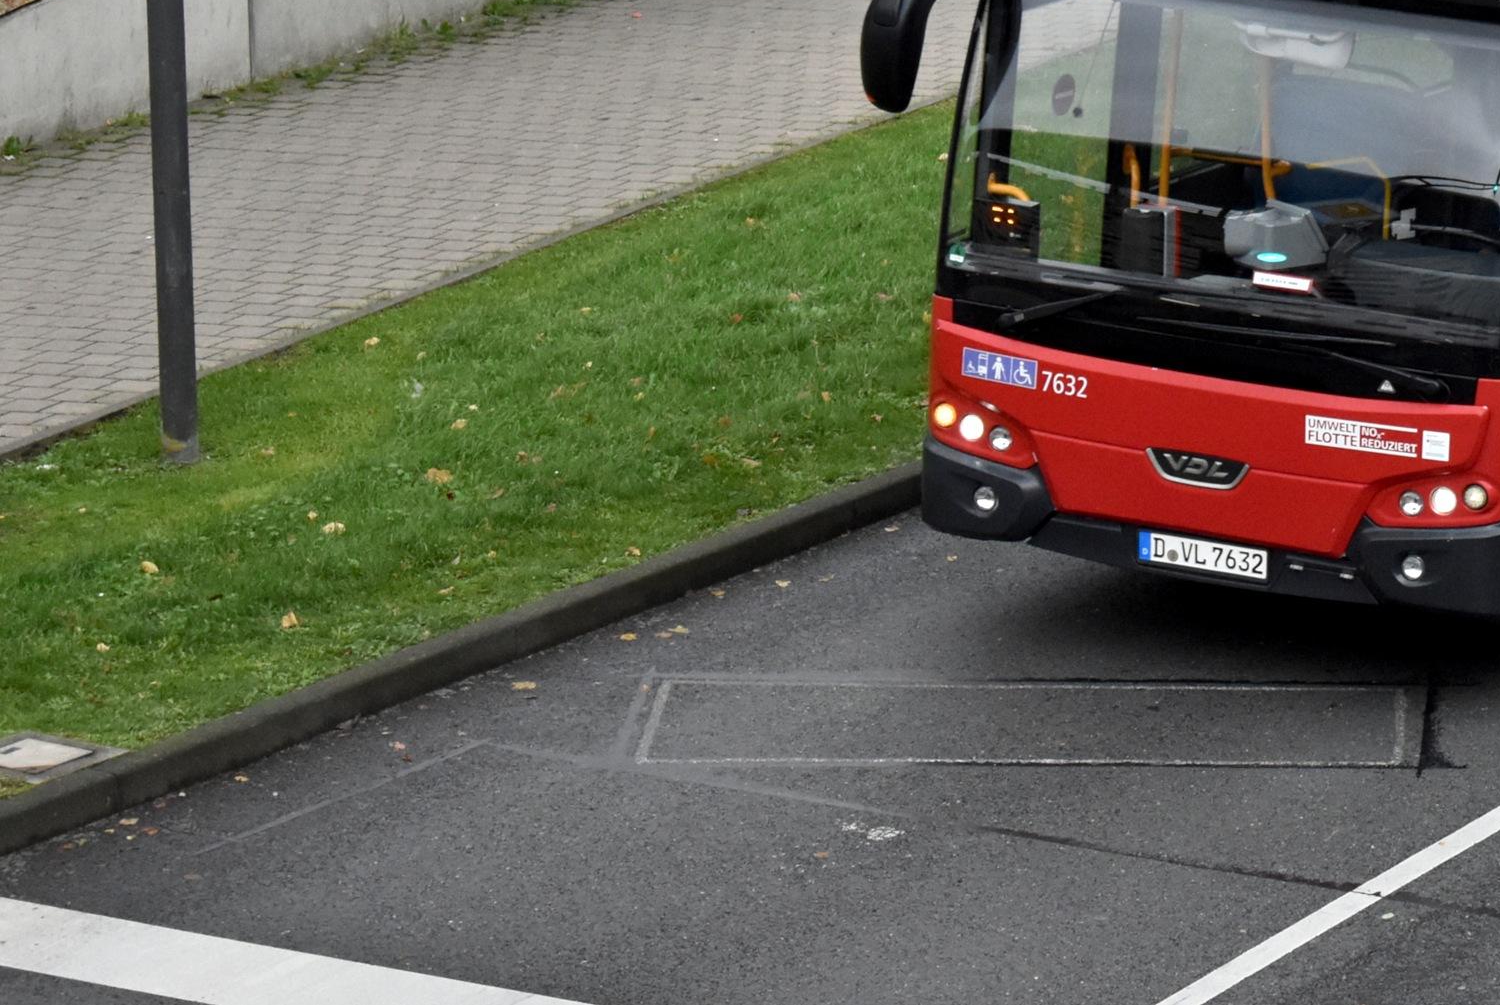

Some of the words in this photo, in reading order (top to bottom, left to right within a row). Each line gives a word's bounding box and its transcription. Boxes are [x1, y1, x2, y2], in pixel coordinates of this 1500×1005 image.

[1041, 370, 1088, 399] 7632
[1307, 418, 1358, 434] UMWELT
[1307, 430, 1358, 446] FLOTTE
[1361, 438, 1418, 453] REDUZIERT
[1163, 453, 1229, 478] VDL
[1153, 537, 1166, 558] D
[1212, 547, 1264, 575] 7632
